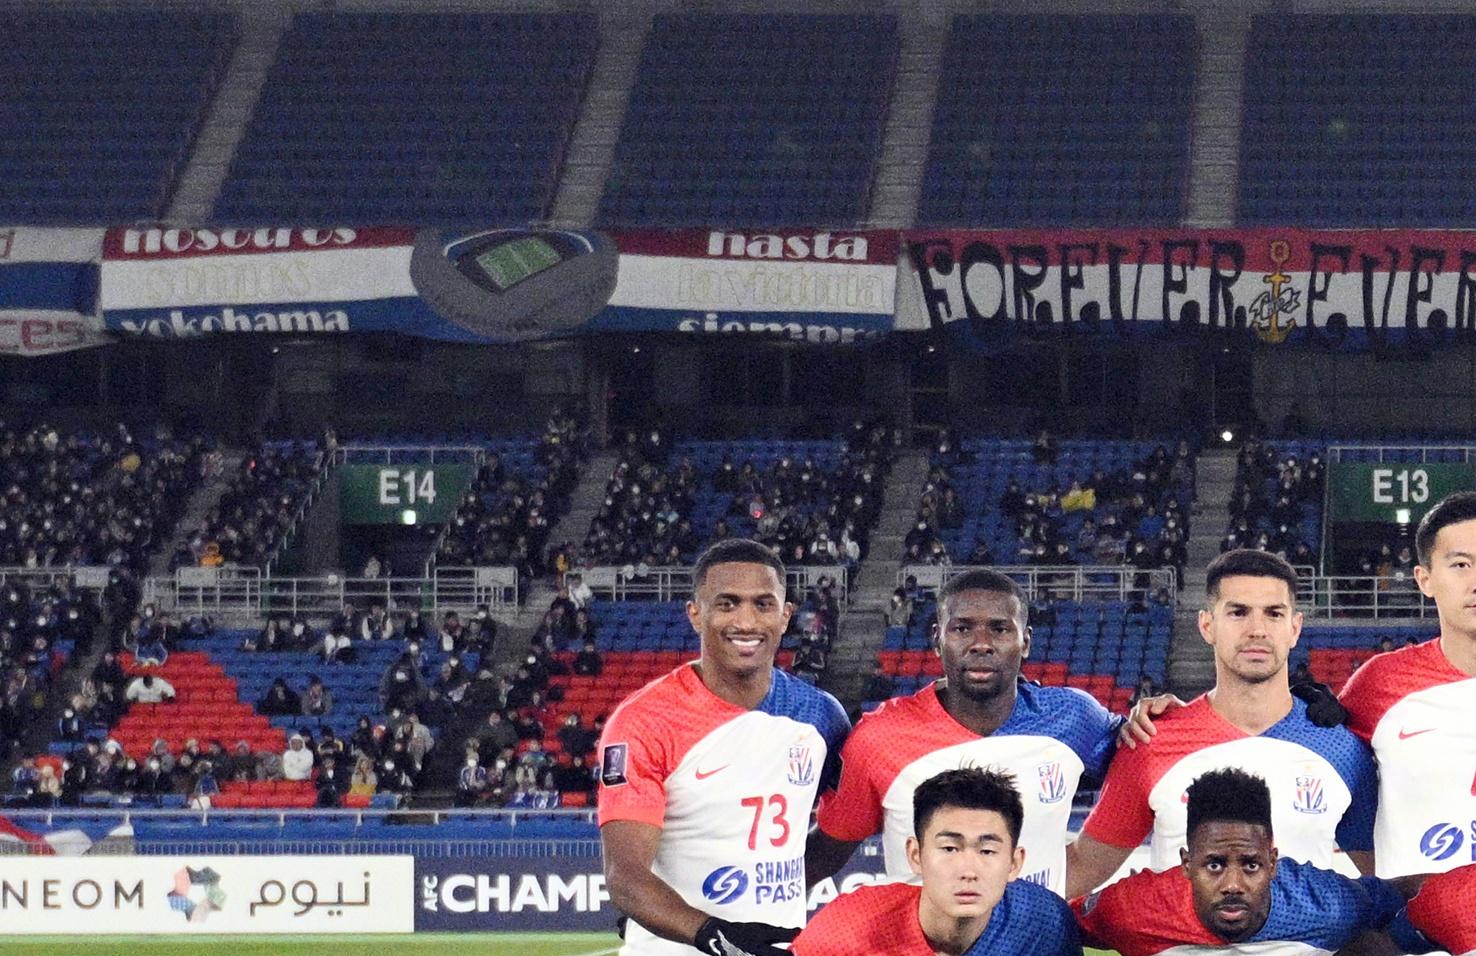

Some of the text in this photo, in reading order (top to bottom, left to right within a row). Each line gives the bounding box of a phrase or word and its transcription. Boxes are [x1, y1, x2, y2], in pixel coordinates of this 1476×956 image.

[918, 238, 1248, 334] FOREVER
[380, 469, 436, 505] E14
[1373, 469, 1429, 503] E13
[740, 793, 791, 850] 73
[0, 879, 145, 908] NEOM
[250, 872, 371, 917] نيوم
[424, 875, 438, 912] AFC
